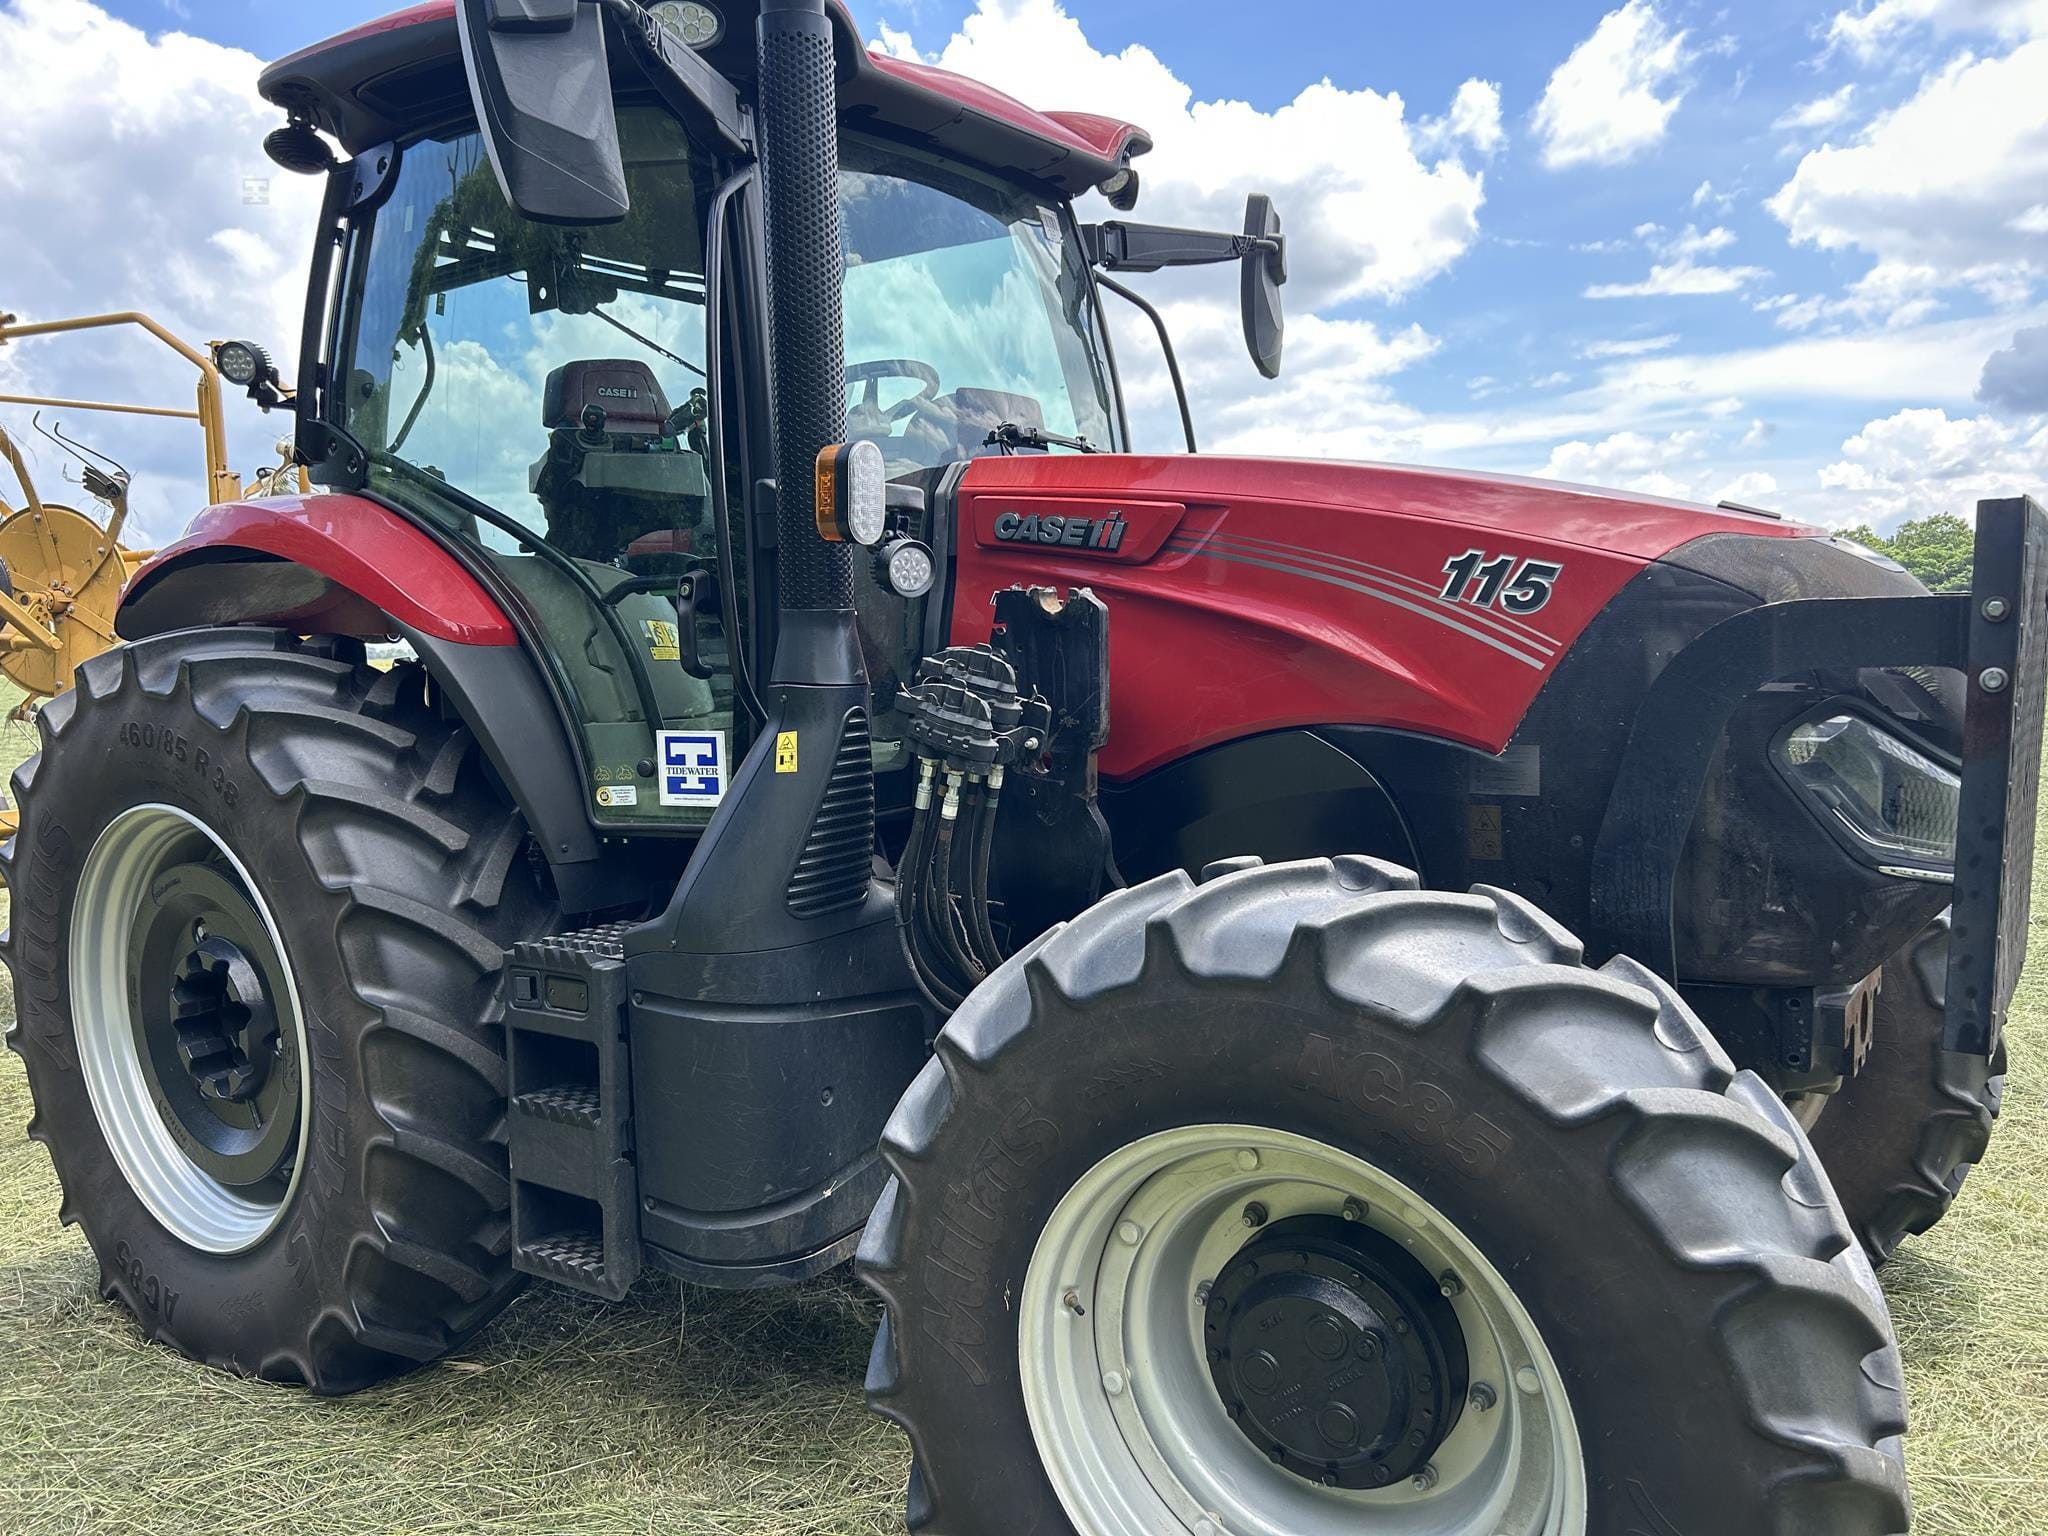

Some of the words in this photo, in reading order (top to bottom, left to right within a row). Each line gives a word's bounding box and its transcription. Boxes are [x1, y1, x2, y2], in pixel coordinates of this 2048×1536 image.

[994, 511, 1092, 547] CASE
[1438, 548, 1565, 616] 115
[120, 721, 188, 762] 460/85
[194, 745, 211, 779] R
[212, 764, 241, 808] 38
[666, 766, 719, 776] TIDEWATER
[1289, 1031, 1514, 1181] AC85
[114, 1239, 182, 1327] AC85
